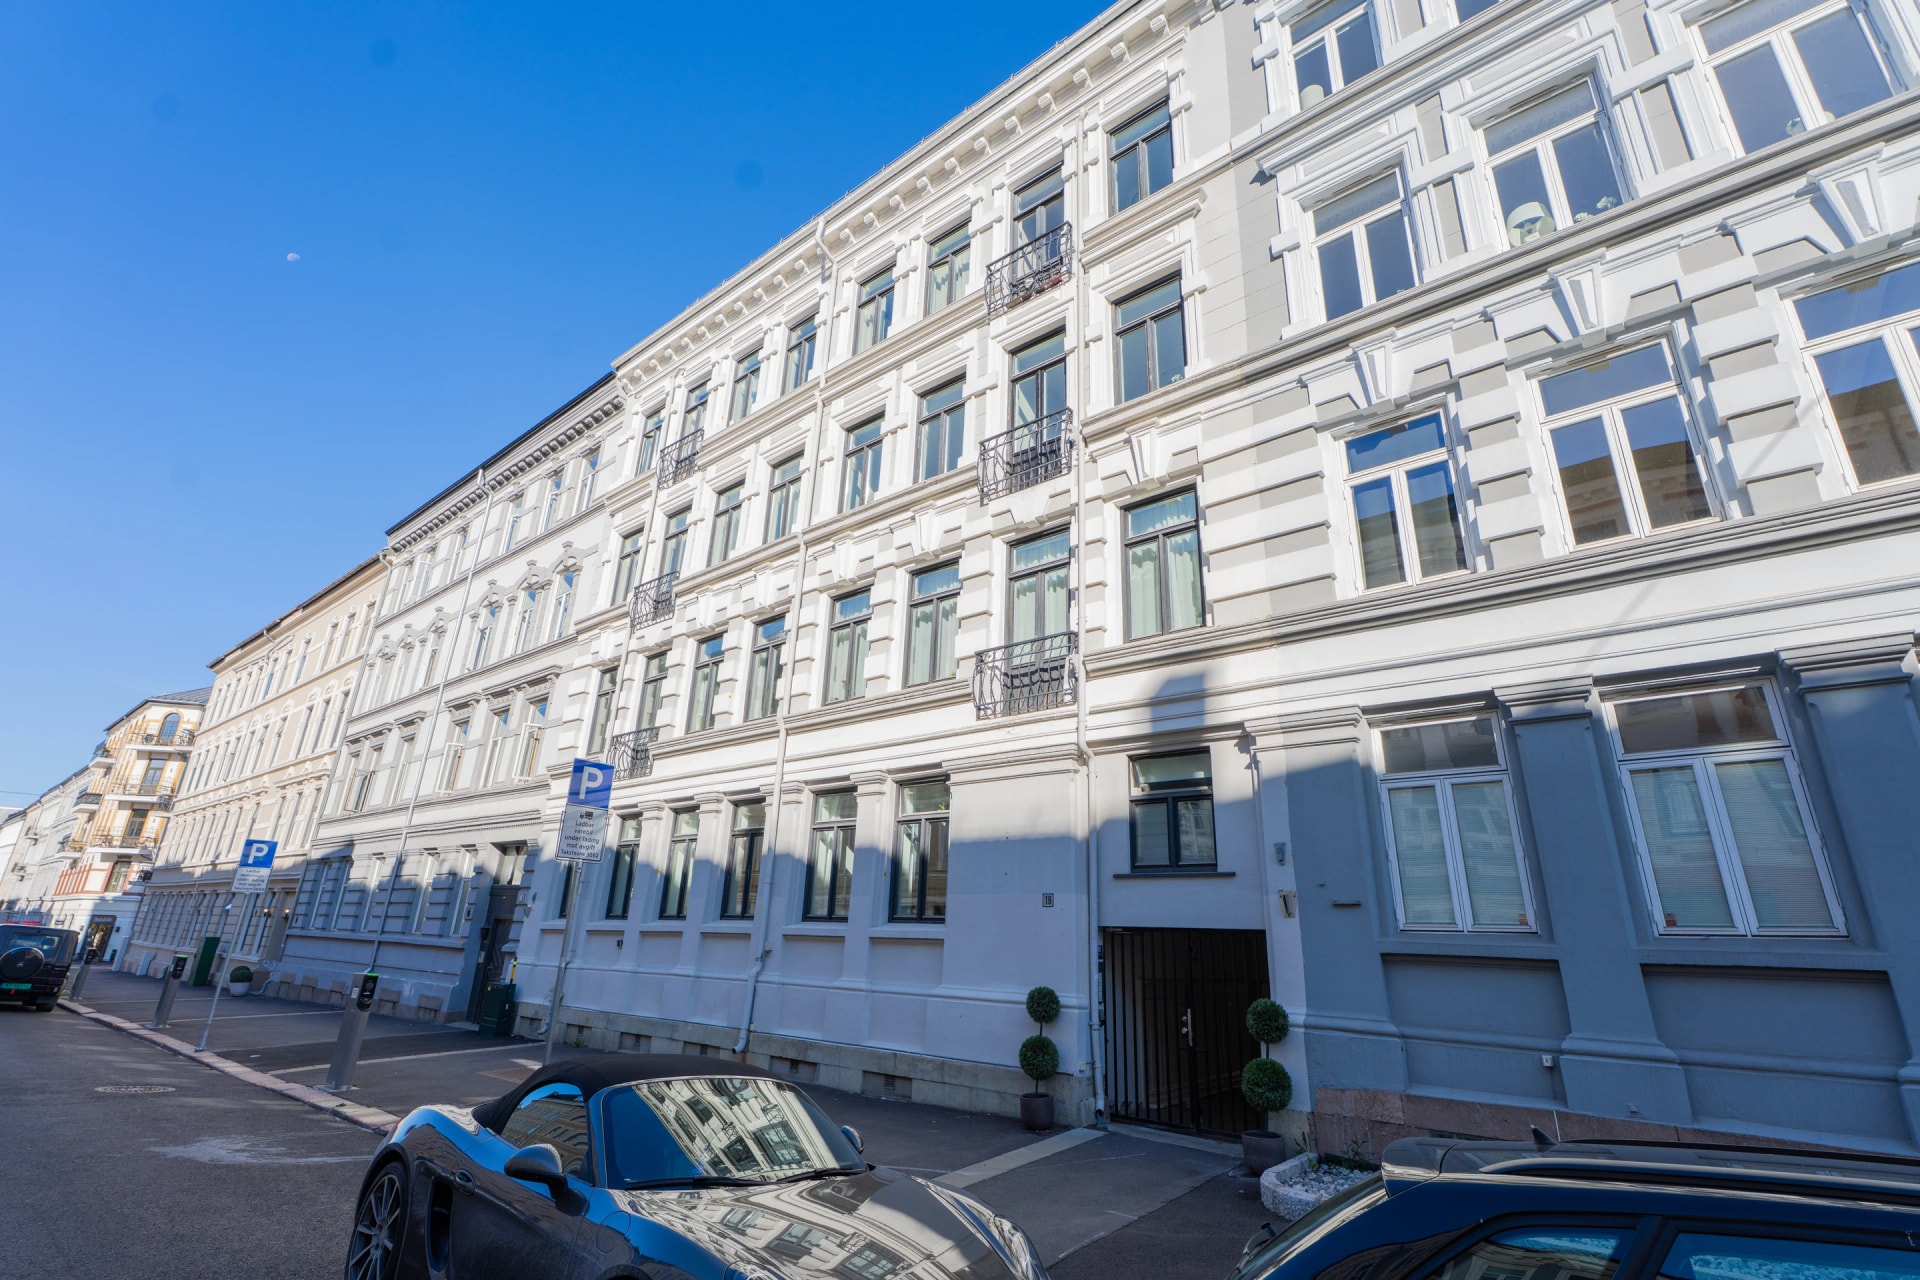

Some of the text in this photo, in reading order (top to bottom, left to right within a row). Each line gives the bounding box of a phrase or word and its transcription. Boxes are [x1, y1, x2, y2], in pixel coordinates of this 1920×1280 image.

[579, 765, 604, 800] P
[575, 820, 595, 828] Ladbar
[582, 836, 600, 844] lading
[247, 843, 269, 864] P
